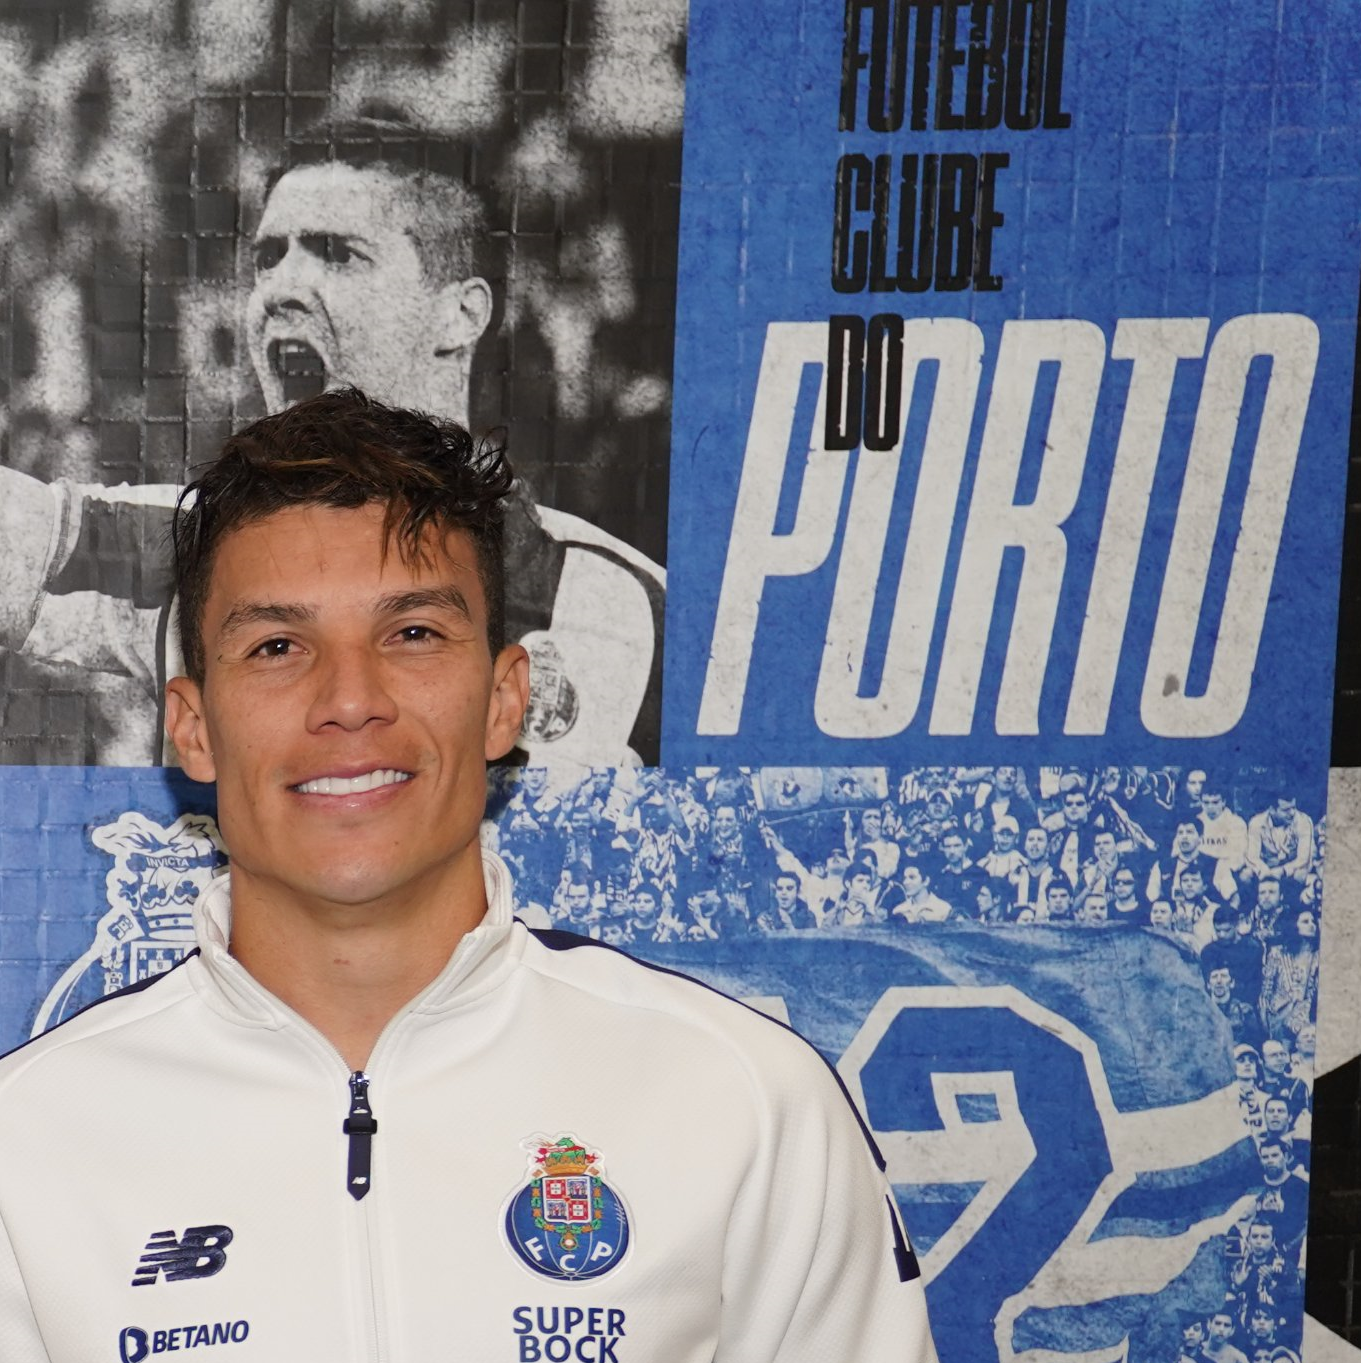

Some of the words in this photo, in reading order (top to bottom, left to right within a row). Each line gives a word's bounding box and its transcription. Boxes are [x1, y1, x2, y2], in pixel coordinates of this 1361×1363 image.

[838, 0, 1072, 132] FUTEBOL
[831, 153, 1010, 293] CLUBE
[825, 313, 905, 451] DO
[696, 313, 1320, 738] PORTO
[146, 856, 189, 868] INVICTA
[131, 1224, 234, 1287] NB
[152, 1320, 250, 1354] BETANO
[512, 1306, 626, 1337] SUPER
